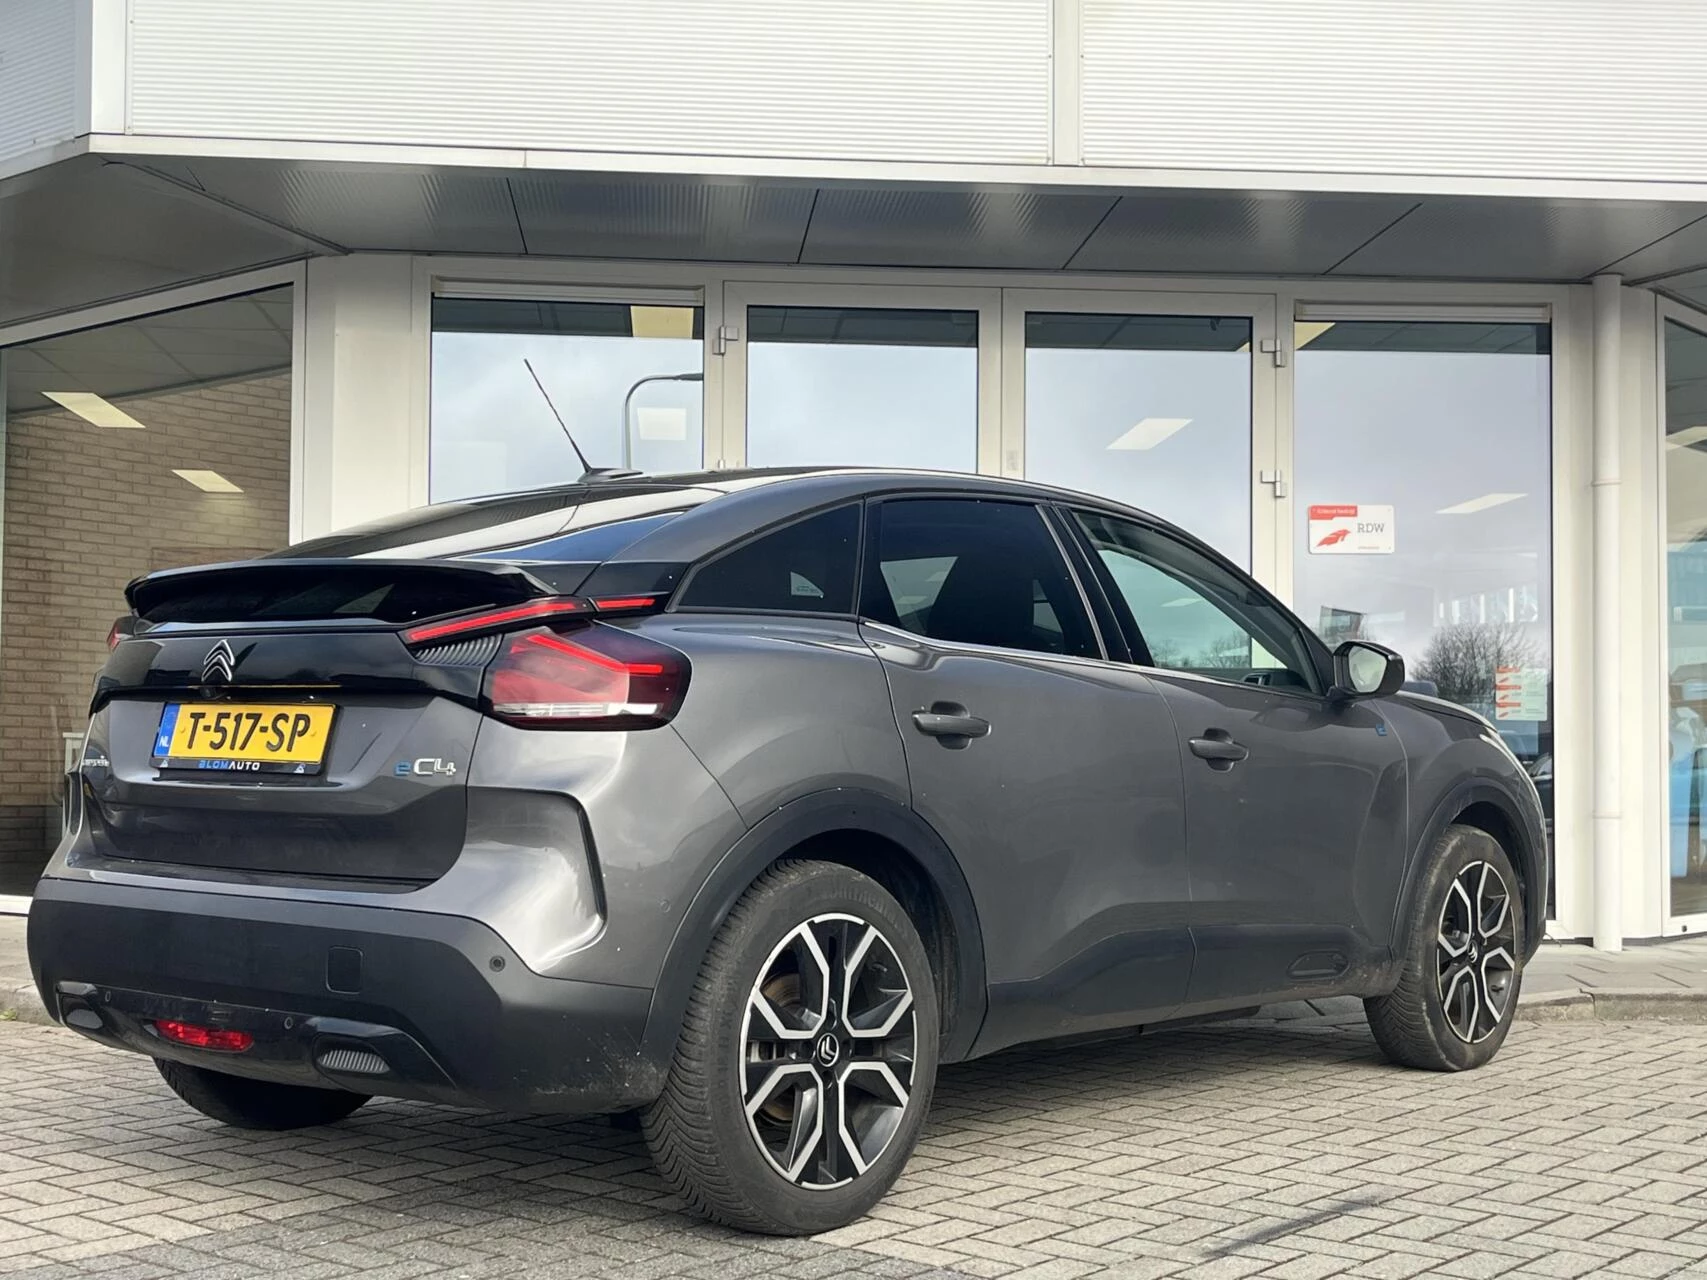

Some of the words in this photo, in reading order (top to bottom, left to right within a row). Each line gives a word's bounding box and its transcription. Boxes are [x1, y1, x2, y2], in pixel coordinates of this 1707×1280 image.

[1357, 522, 1385, 533] RDW
[187, 712, 311, 753] T-517-SP
[158, 735, 170, 748] NL
